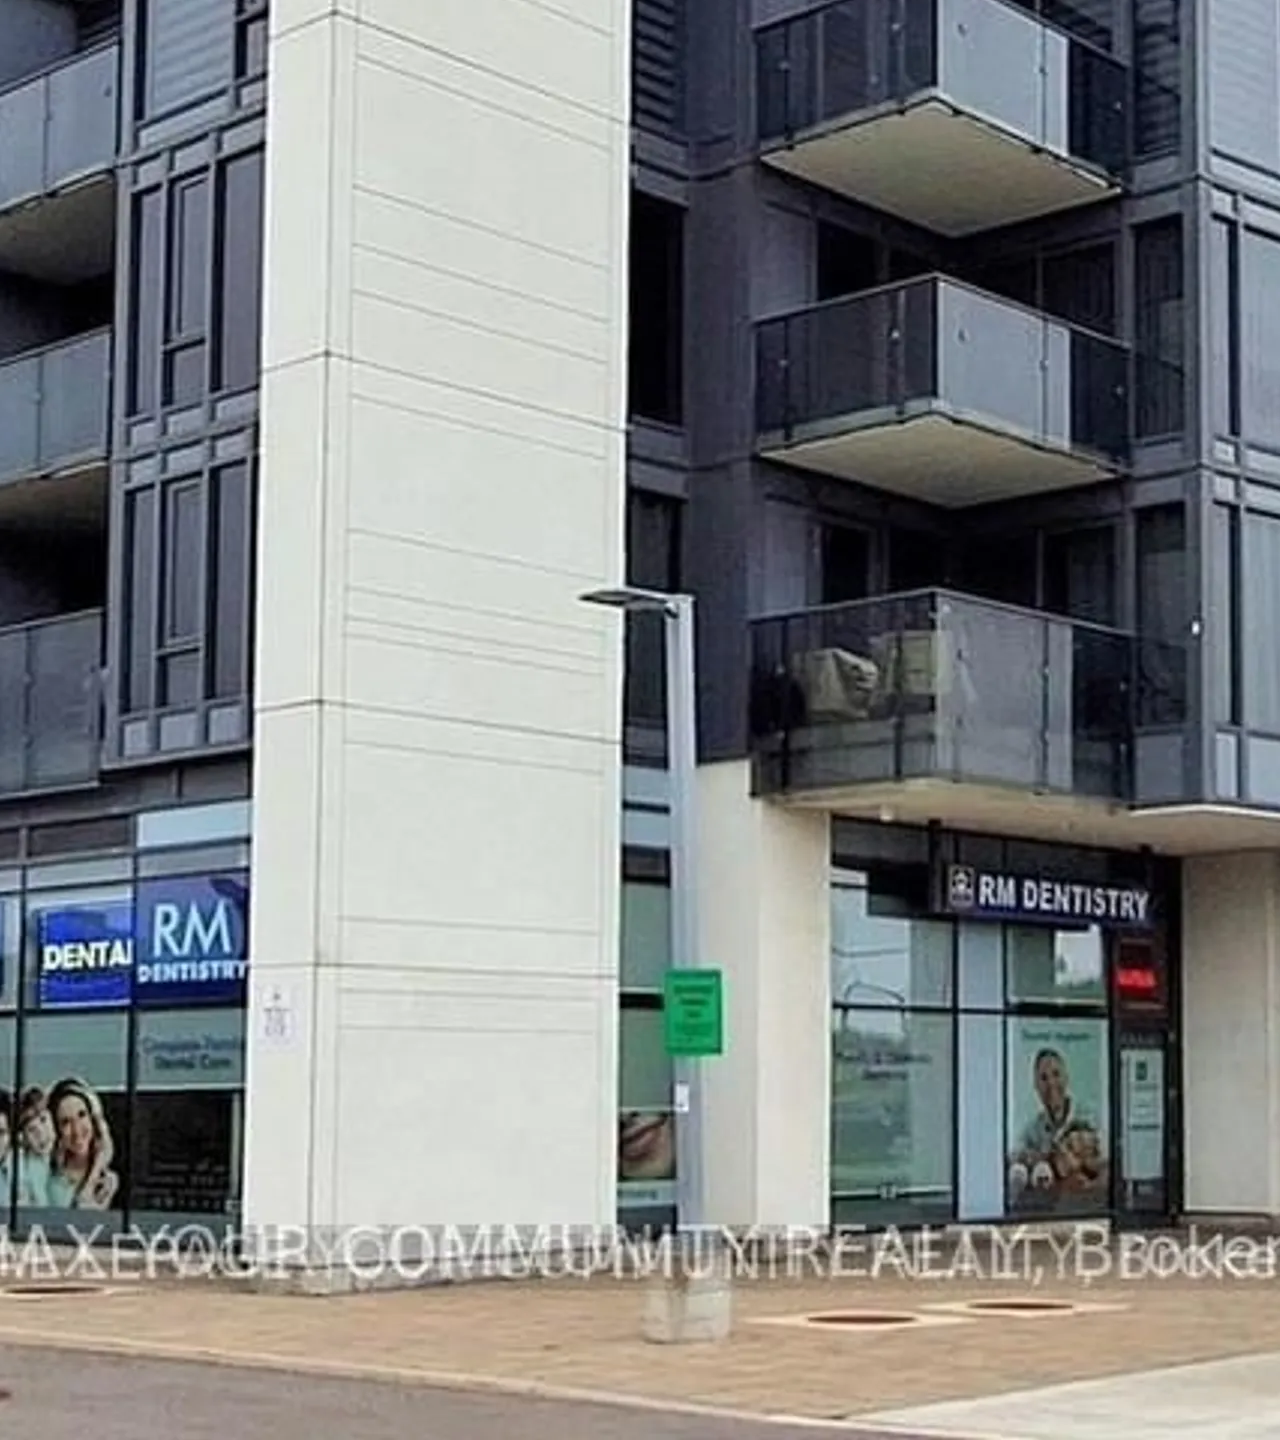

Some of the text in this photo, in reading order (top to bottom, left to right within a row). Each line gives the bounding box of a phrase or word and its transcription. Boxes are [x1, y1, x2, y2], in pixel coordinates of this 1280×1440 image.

[978, 874, 1149, 921] RM DENTISTRY
[153, 899, 232, 958] RM
[137, 960, 246, 984] DENTISTRY
